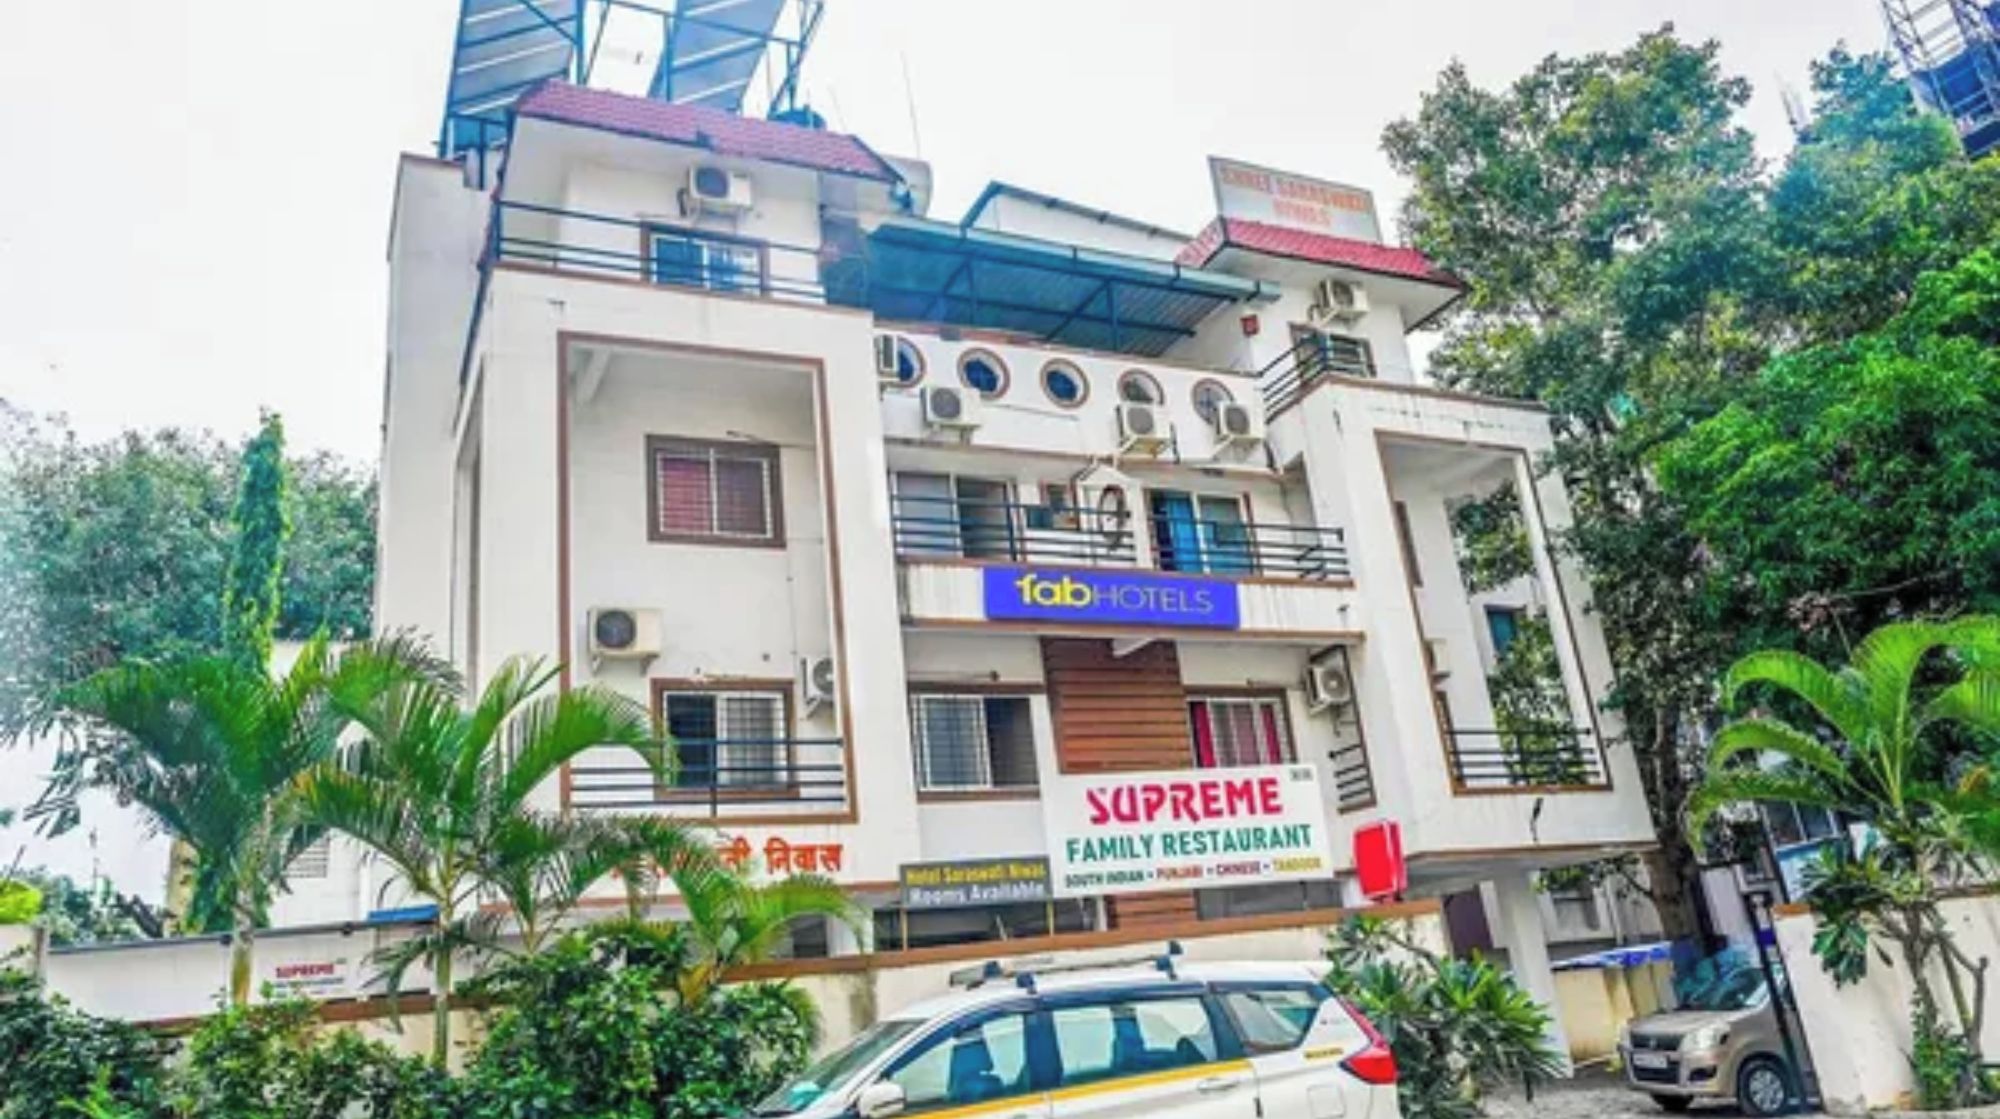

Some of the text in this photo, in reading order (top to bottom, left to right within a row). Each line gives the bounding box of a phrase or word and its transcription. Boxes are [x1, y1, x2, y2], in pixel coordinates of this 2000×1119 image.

[1015, 573, 1214, 614] fabHOTELS
[1086, 777, 1283, 825] SUPREME
[764, 837, 843, 874] निवास
[1065, 824, 1312, 864] FAMILY RESTAURANT
[906, 868, 942, 886] Hotel
[1065, 873, 1102, 889] SOUTH
[1106, 870, 1145, 885] INDIAN
[1156, 866, 1203, 881] PUNJABI
[1216, 861, 1260, 876] CHINESE
[909, 881, 1045, 905] Rooms Available
[275, 964, 334, 978] SUPREME
